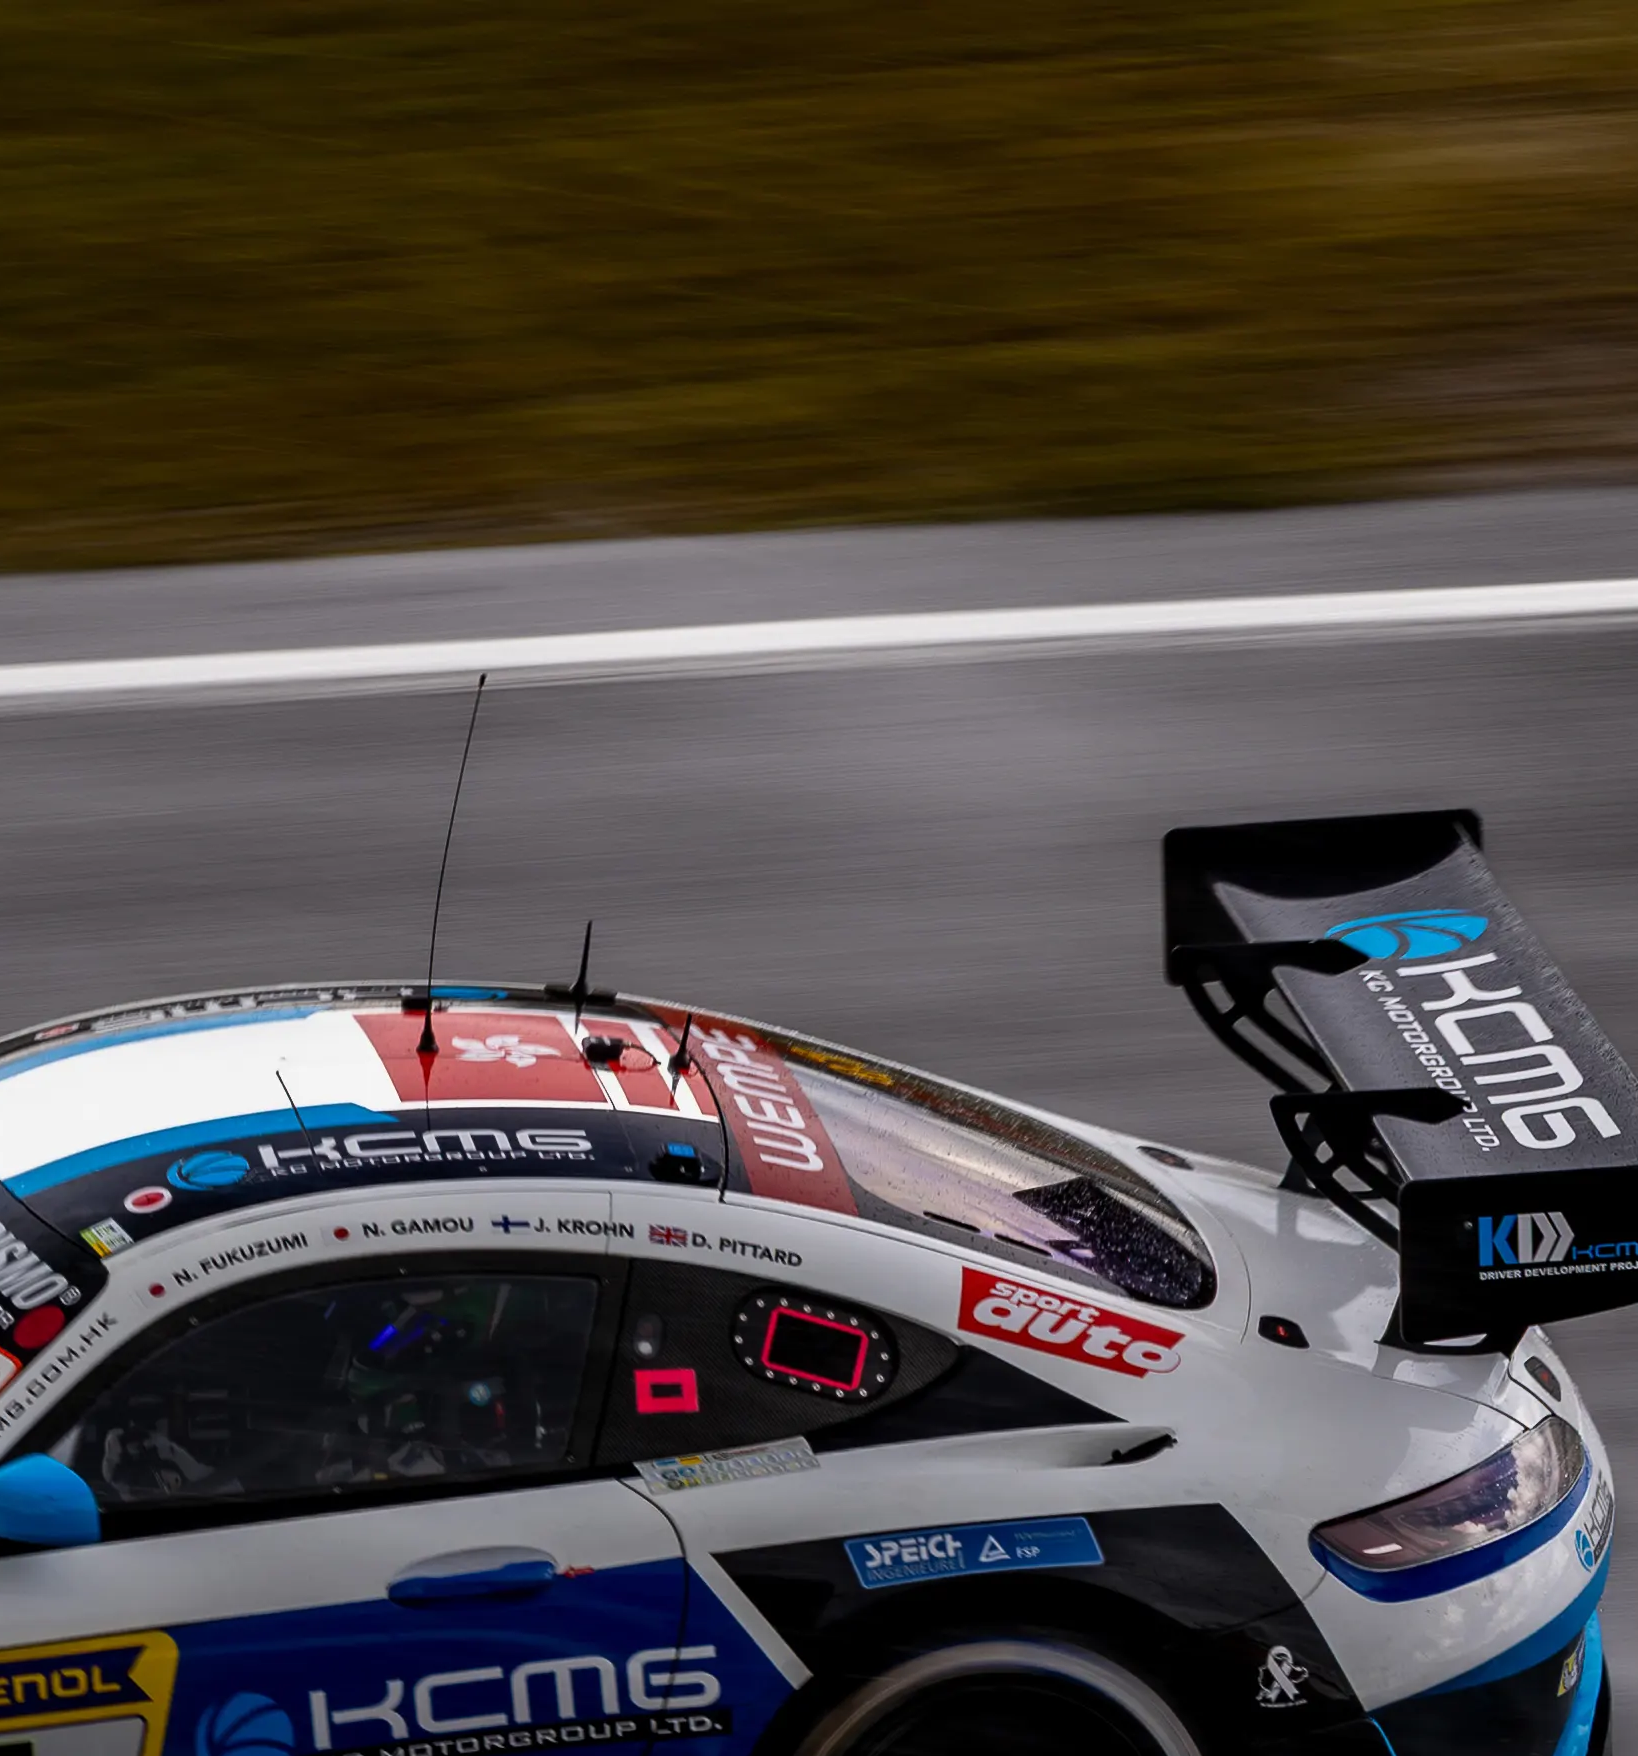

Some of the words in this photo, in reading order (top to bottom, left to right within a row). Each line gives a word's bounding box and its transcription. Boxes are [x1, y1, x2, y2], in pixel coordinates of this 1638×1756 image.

[1396, 952, 1621, 1149] KCMG
[691, 1026, 824, 1171] WEMPE
[258, 1129, 592, 1169] KCMG
[361, 1223, 386, 1238] N.
[391, 1217, 475, 1236] GAMOU
[534, 1218, 551, 1232] J.
[558, 1219, 635, 1238] KROHN
[173, 1271, 198, 1287] N.
[200, 1232, 309, 1275] FUKUZUMI
[692, 1232, 713, 1251] D.
[719, 1238, 803, 1268] PITTARD
[1479, 1270, 1522, 1281] DRIVER
[1524, 1263, 1607, 1278] DEVELOPMENT
[989, 1281, 1101, 1323] sport
[972, 1296, 1181, 1374] auto
[308, 1645, 722, 1750] KCMG
[651, 1714, 724, 1736] LTD.
